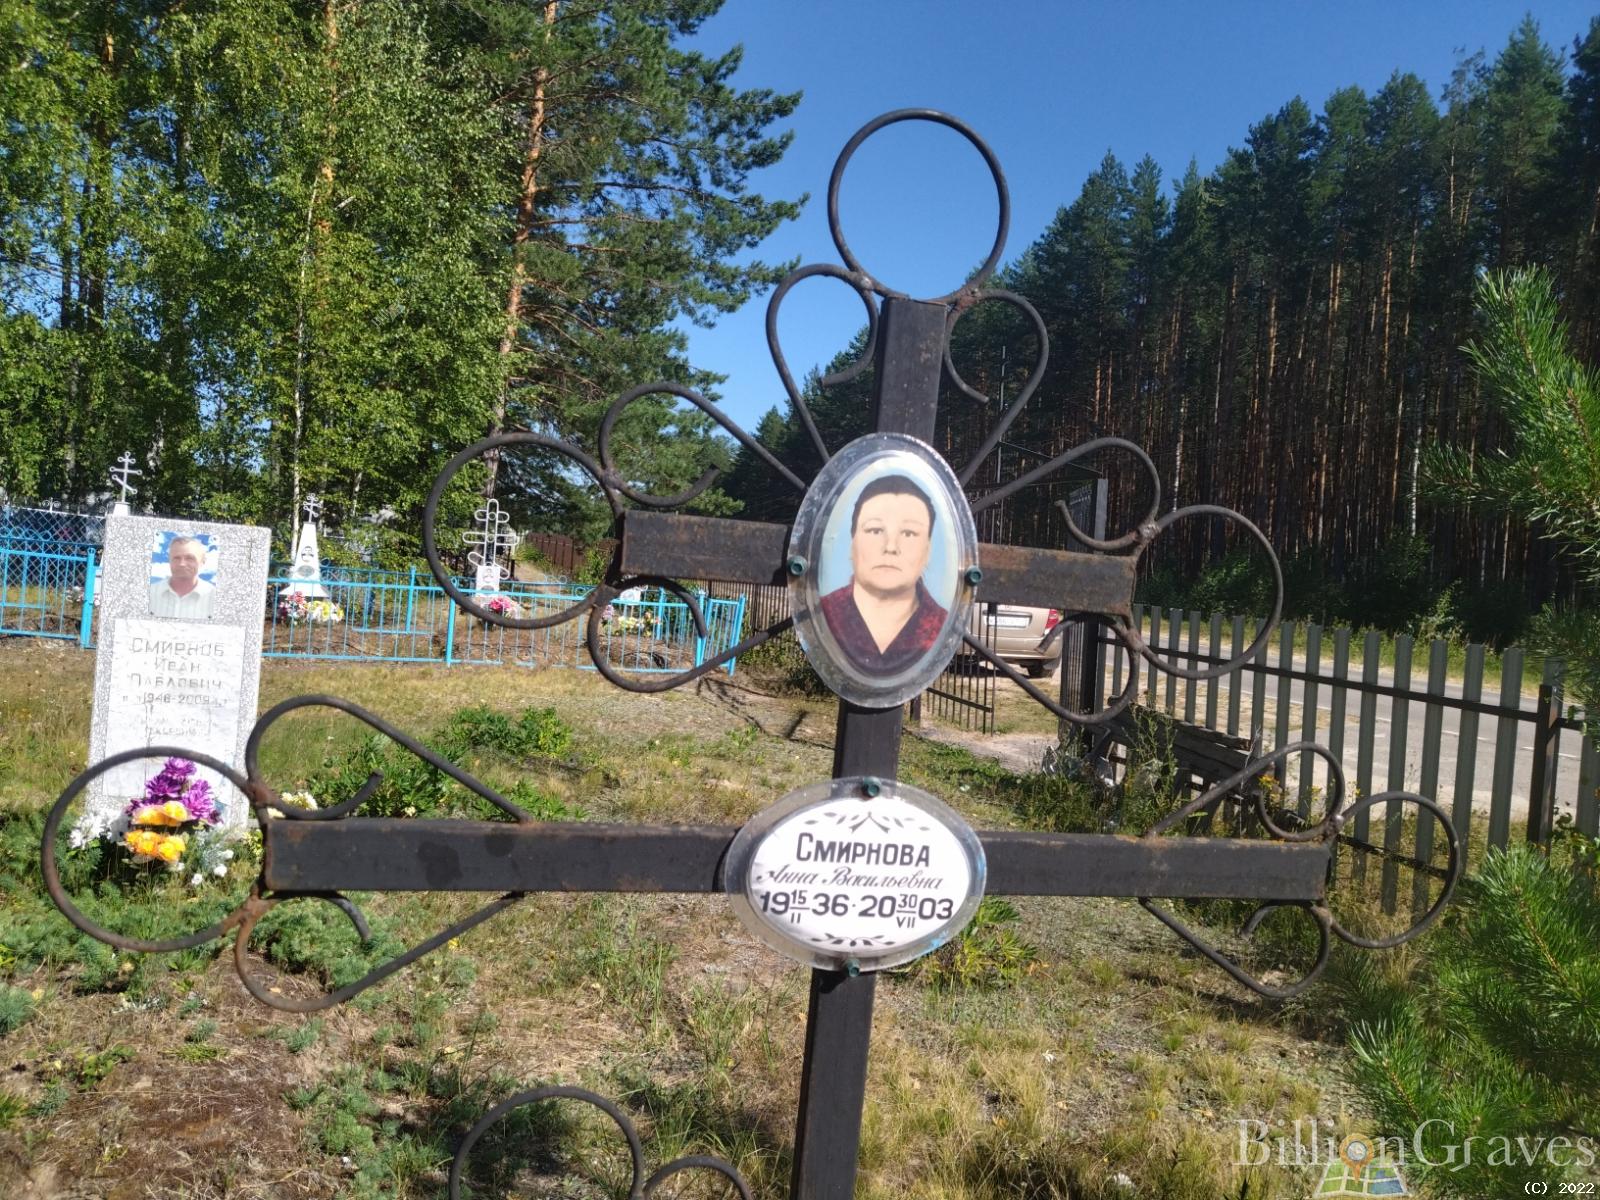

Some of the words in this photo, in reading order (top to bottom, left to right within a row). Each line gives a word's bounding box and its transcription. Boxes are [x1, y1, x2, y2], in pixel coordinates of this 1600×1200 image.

[795, 832, 930, 867] СМИРНОВА
[756, 864, 818, 886] Анна
[821, 866, 944, 890] Васильевна
